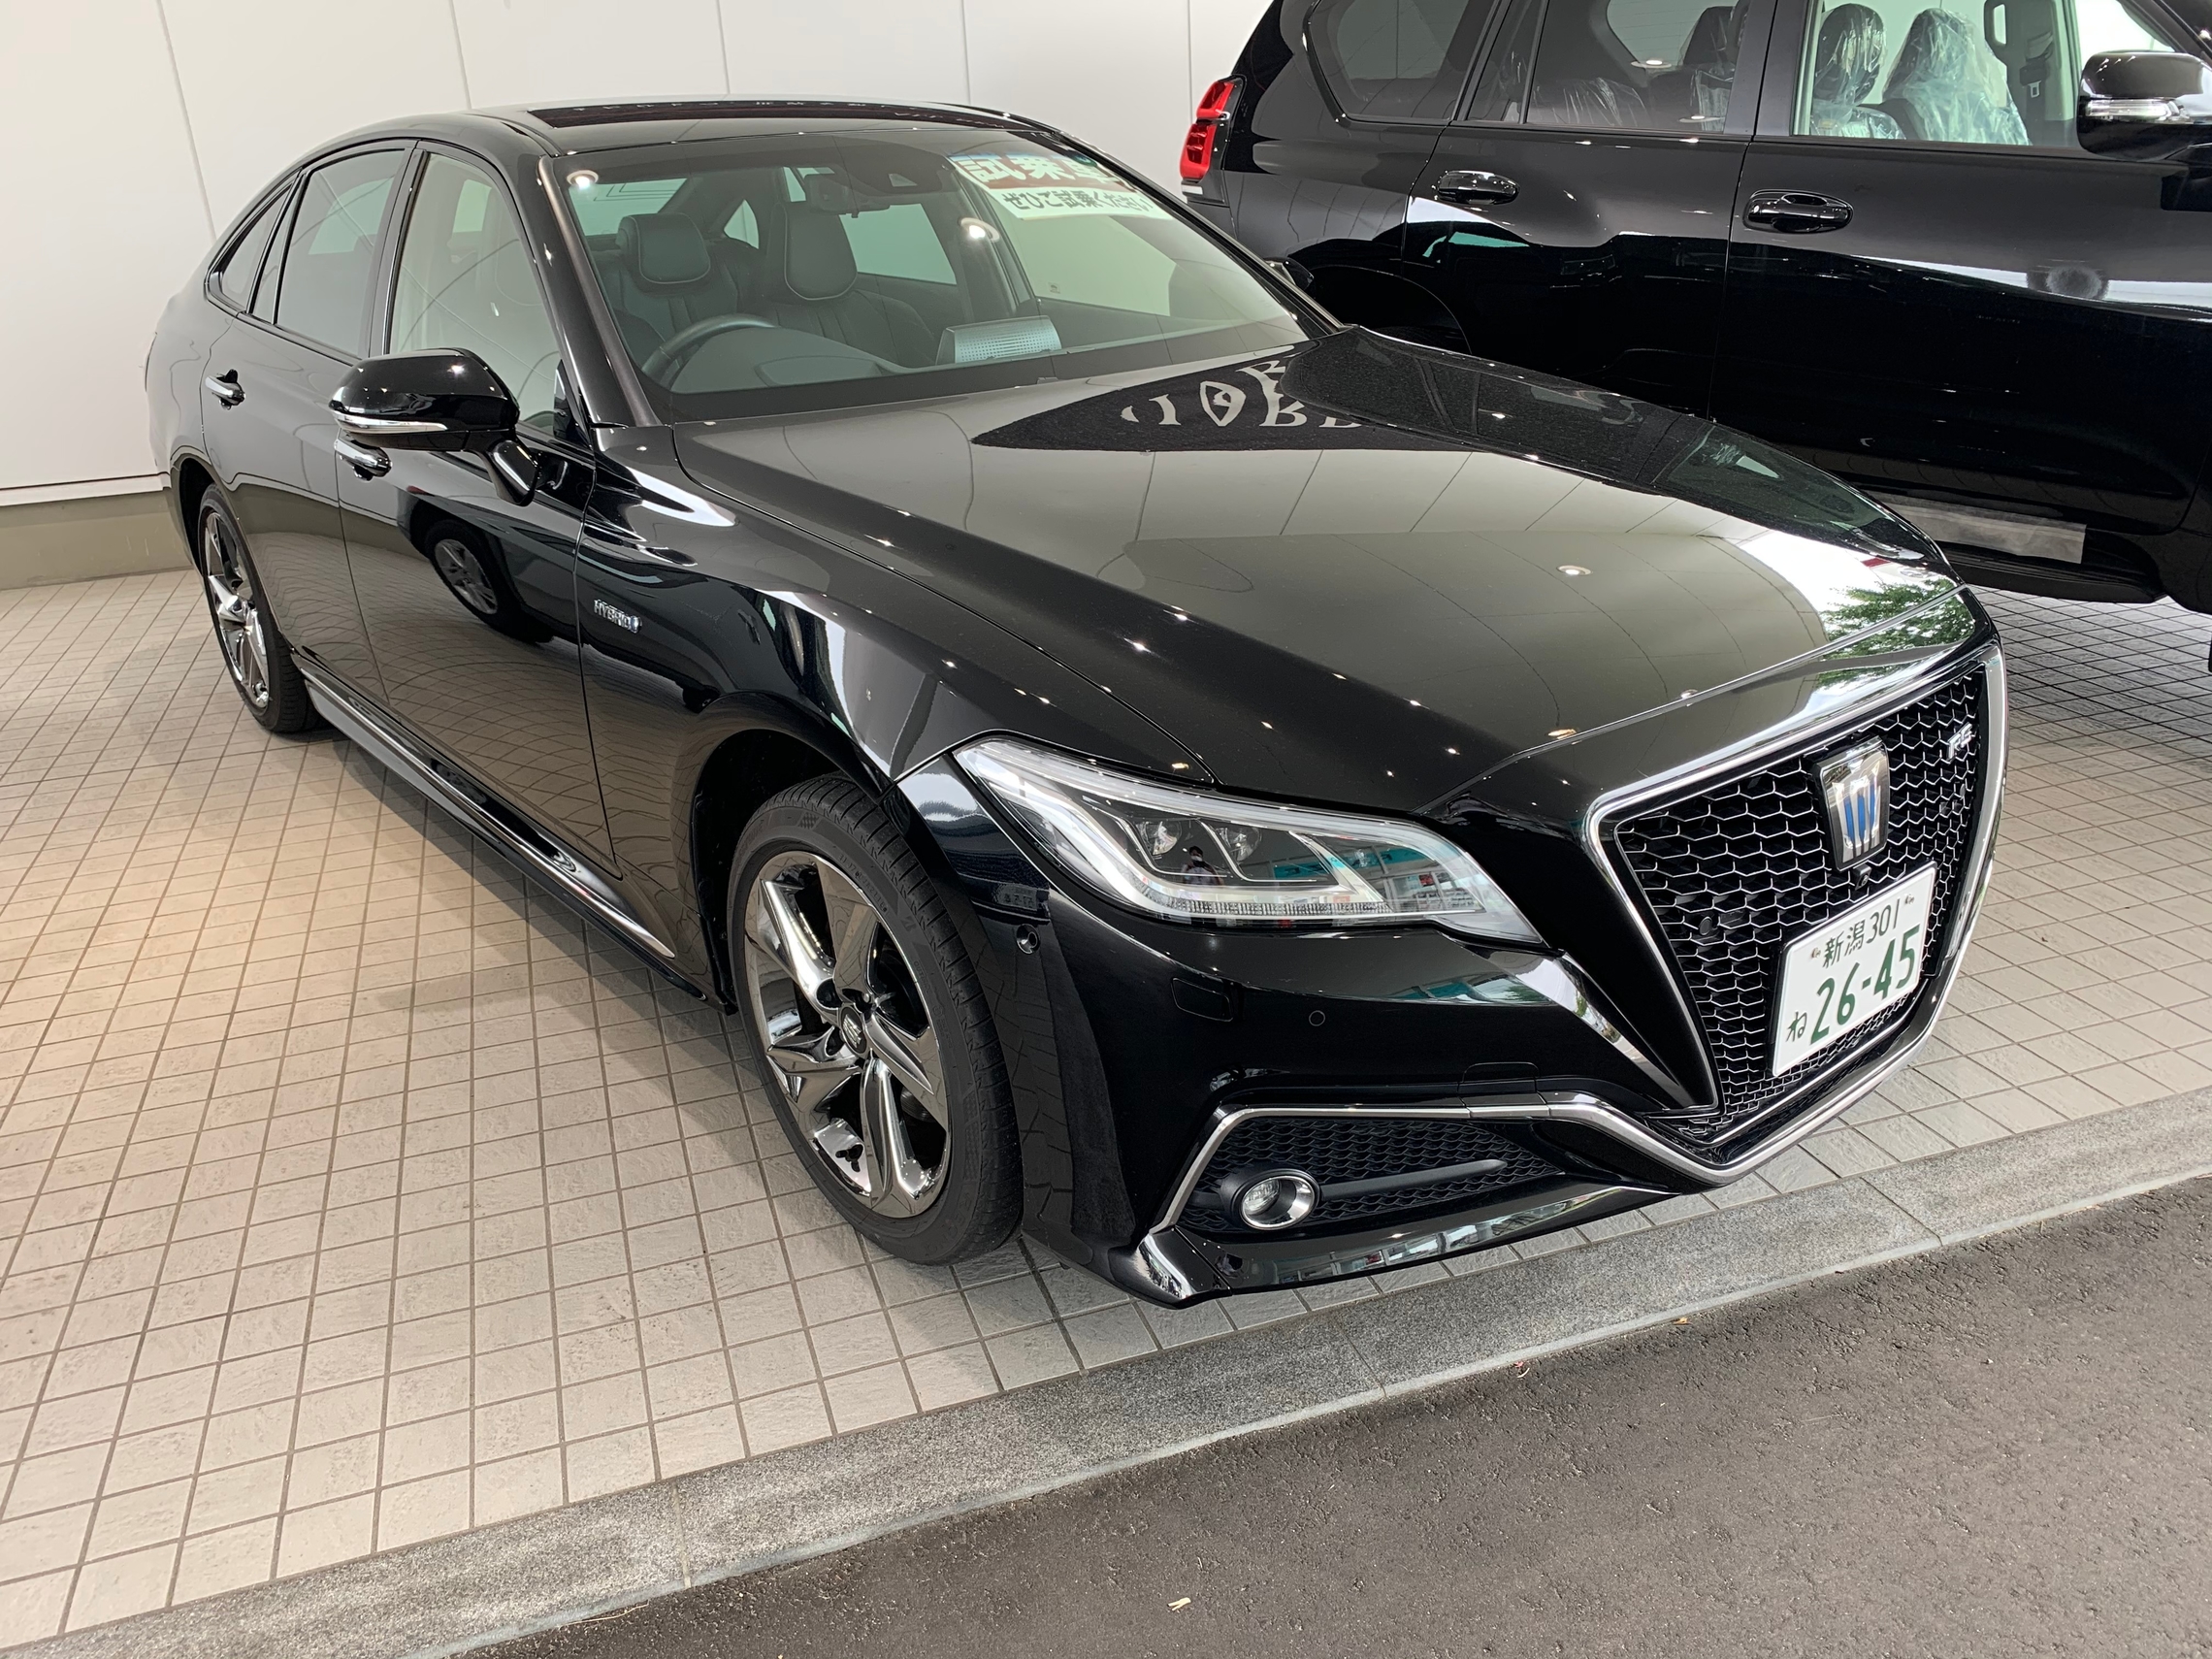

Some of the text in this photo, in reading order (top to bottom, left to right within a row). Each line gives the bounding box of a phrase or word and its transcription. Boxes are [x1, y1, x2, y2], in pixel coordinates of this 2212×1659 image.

[1003, 189, 1155, 211] ぜひご試乗ください
[593, 599, 632, 631] HYBRID
[1809, 923, 1921, 1046] 26-45
